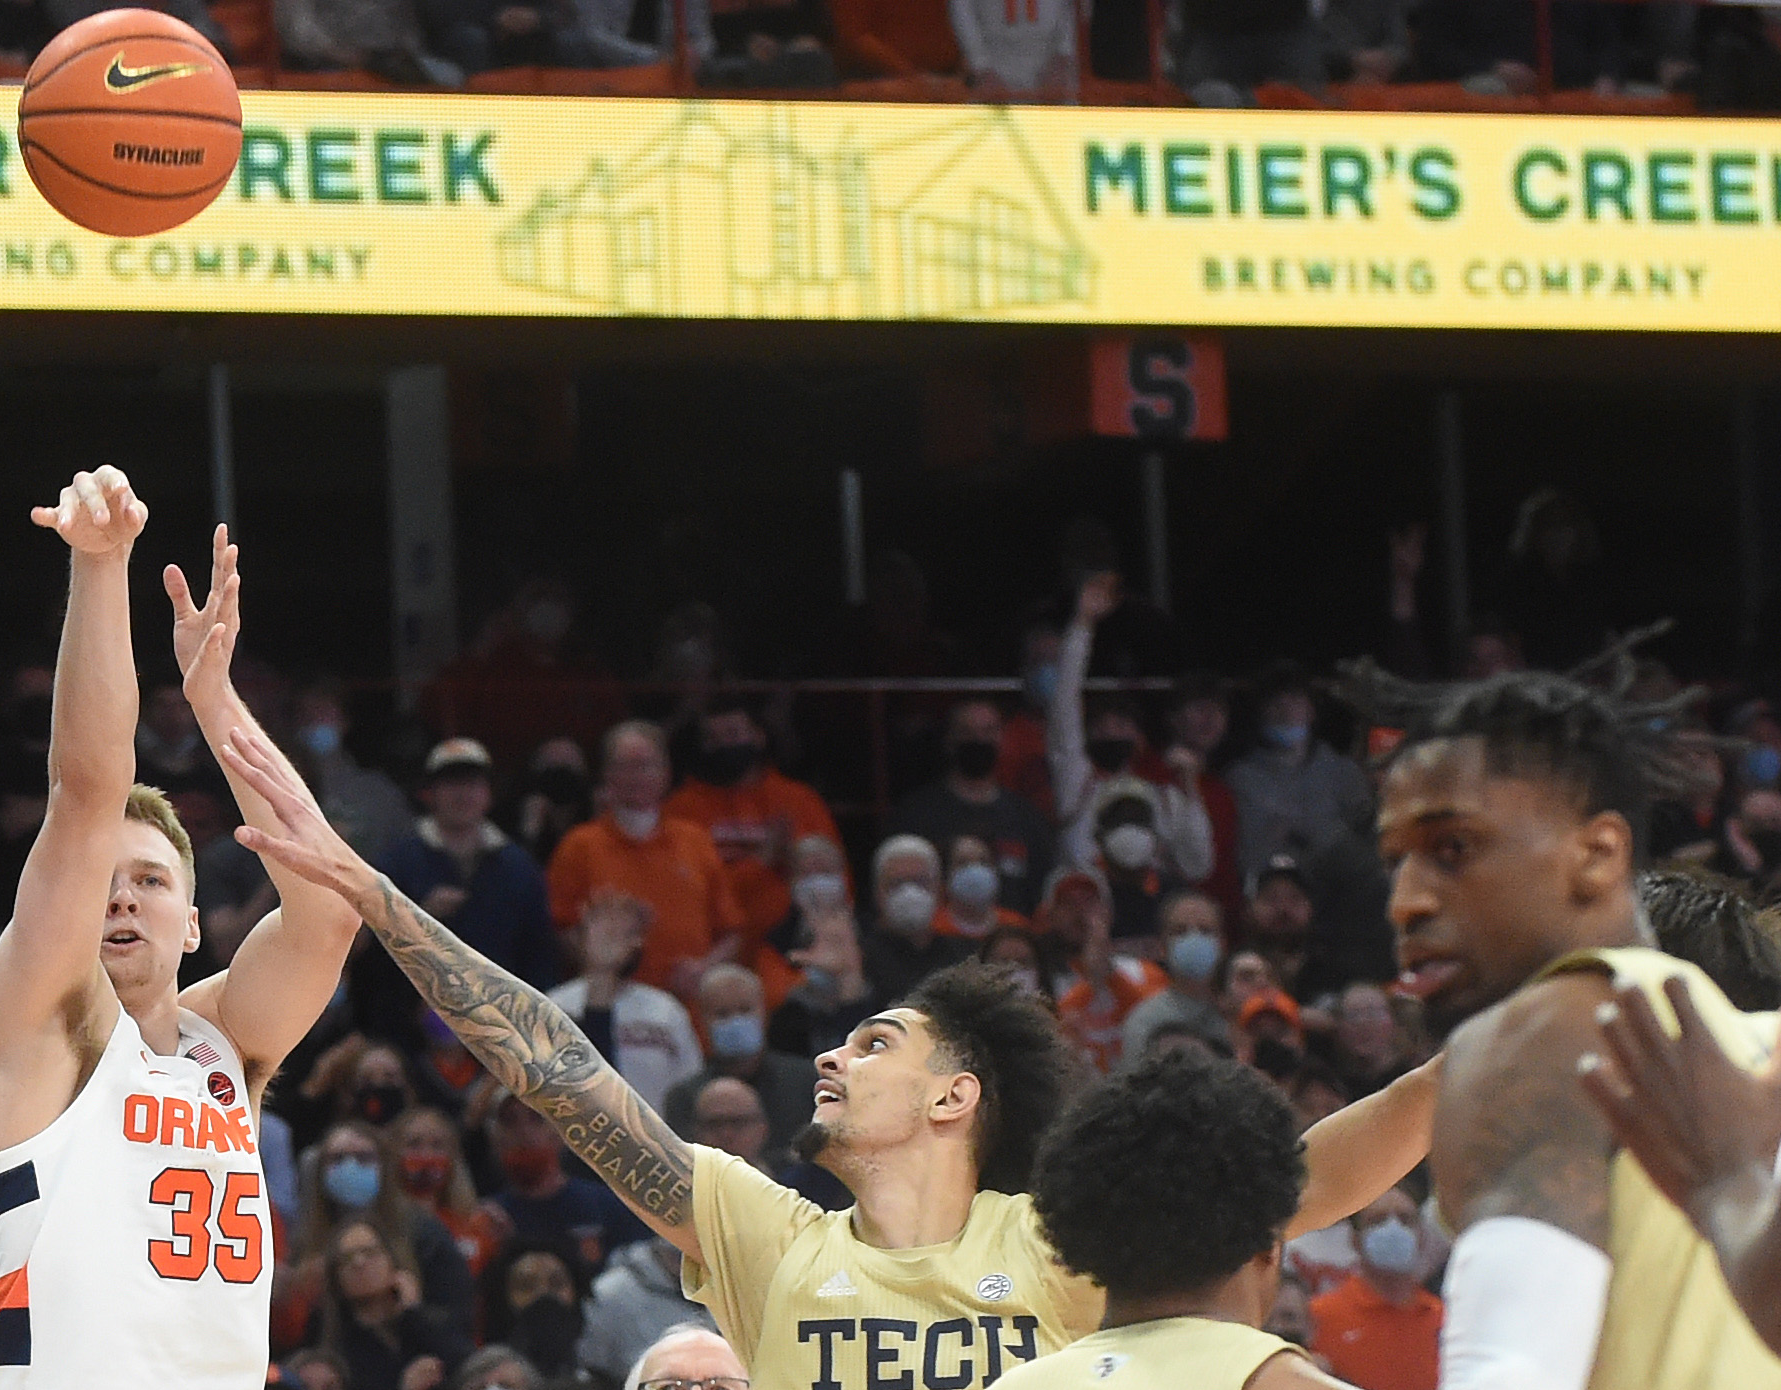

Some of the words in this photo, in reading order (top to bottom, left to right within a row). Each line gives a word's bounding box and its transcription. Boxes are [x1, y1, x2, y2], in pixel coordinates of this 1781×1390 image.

[112, 142, 205, 167] SYRACUSE
[242, 126, 504, 205] REEK
[1083, 142, 1463, 222] MEIER'S
[1512, 149, 1781, 225] CREE
[107, 240, 373, 284] COMPANY
[1203, 256, 1438, 295] BREWING
[1466, 259, 1707, 299] COMPANY
[1126, 338, 1196, 439] S
[565, 1123, 682, 1227] CHANGE
[588, 1111, 627, 1148] BE
[634, 1148, 691, 1201] THE
[147, 1166, 263, 1285] 35
